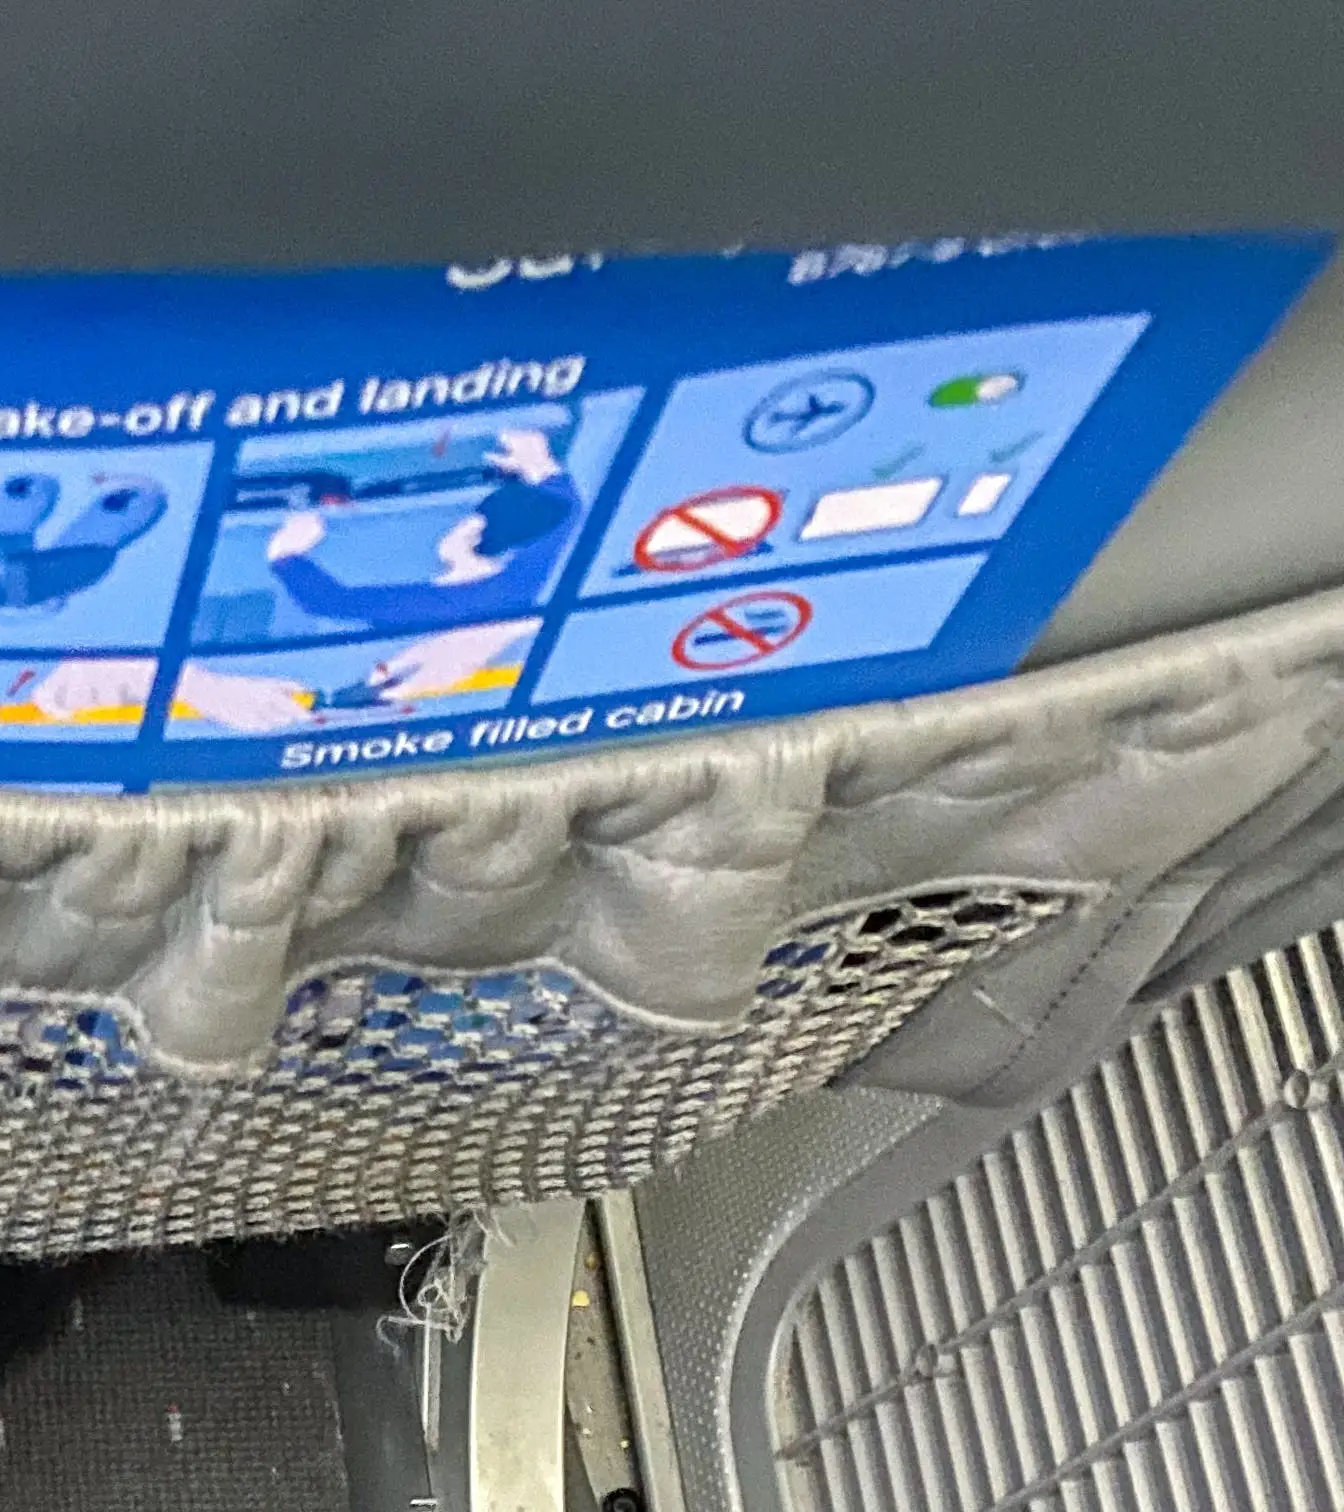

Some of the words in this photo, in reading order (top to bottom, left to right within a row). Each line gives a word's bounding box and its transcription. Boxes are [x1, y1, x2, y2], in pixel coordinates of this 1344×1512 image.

[224, 377, 346, 429] and
[358, 352, 587, 415] landing
[278, 727, 455, 771] Smoke
[468, 706, 595, 749] filled
[603, 688, 747, 729] cabin
